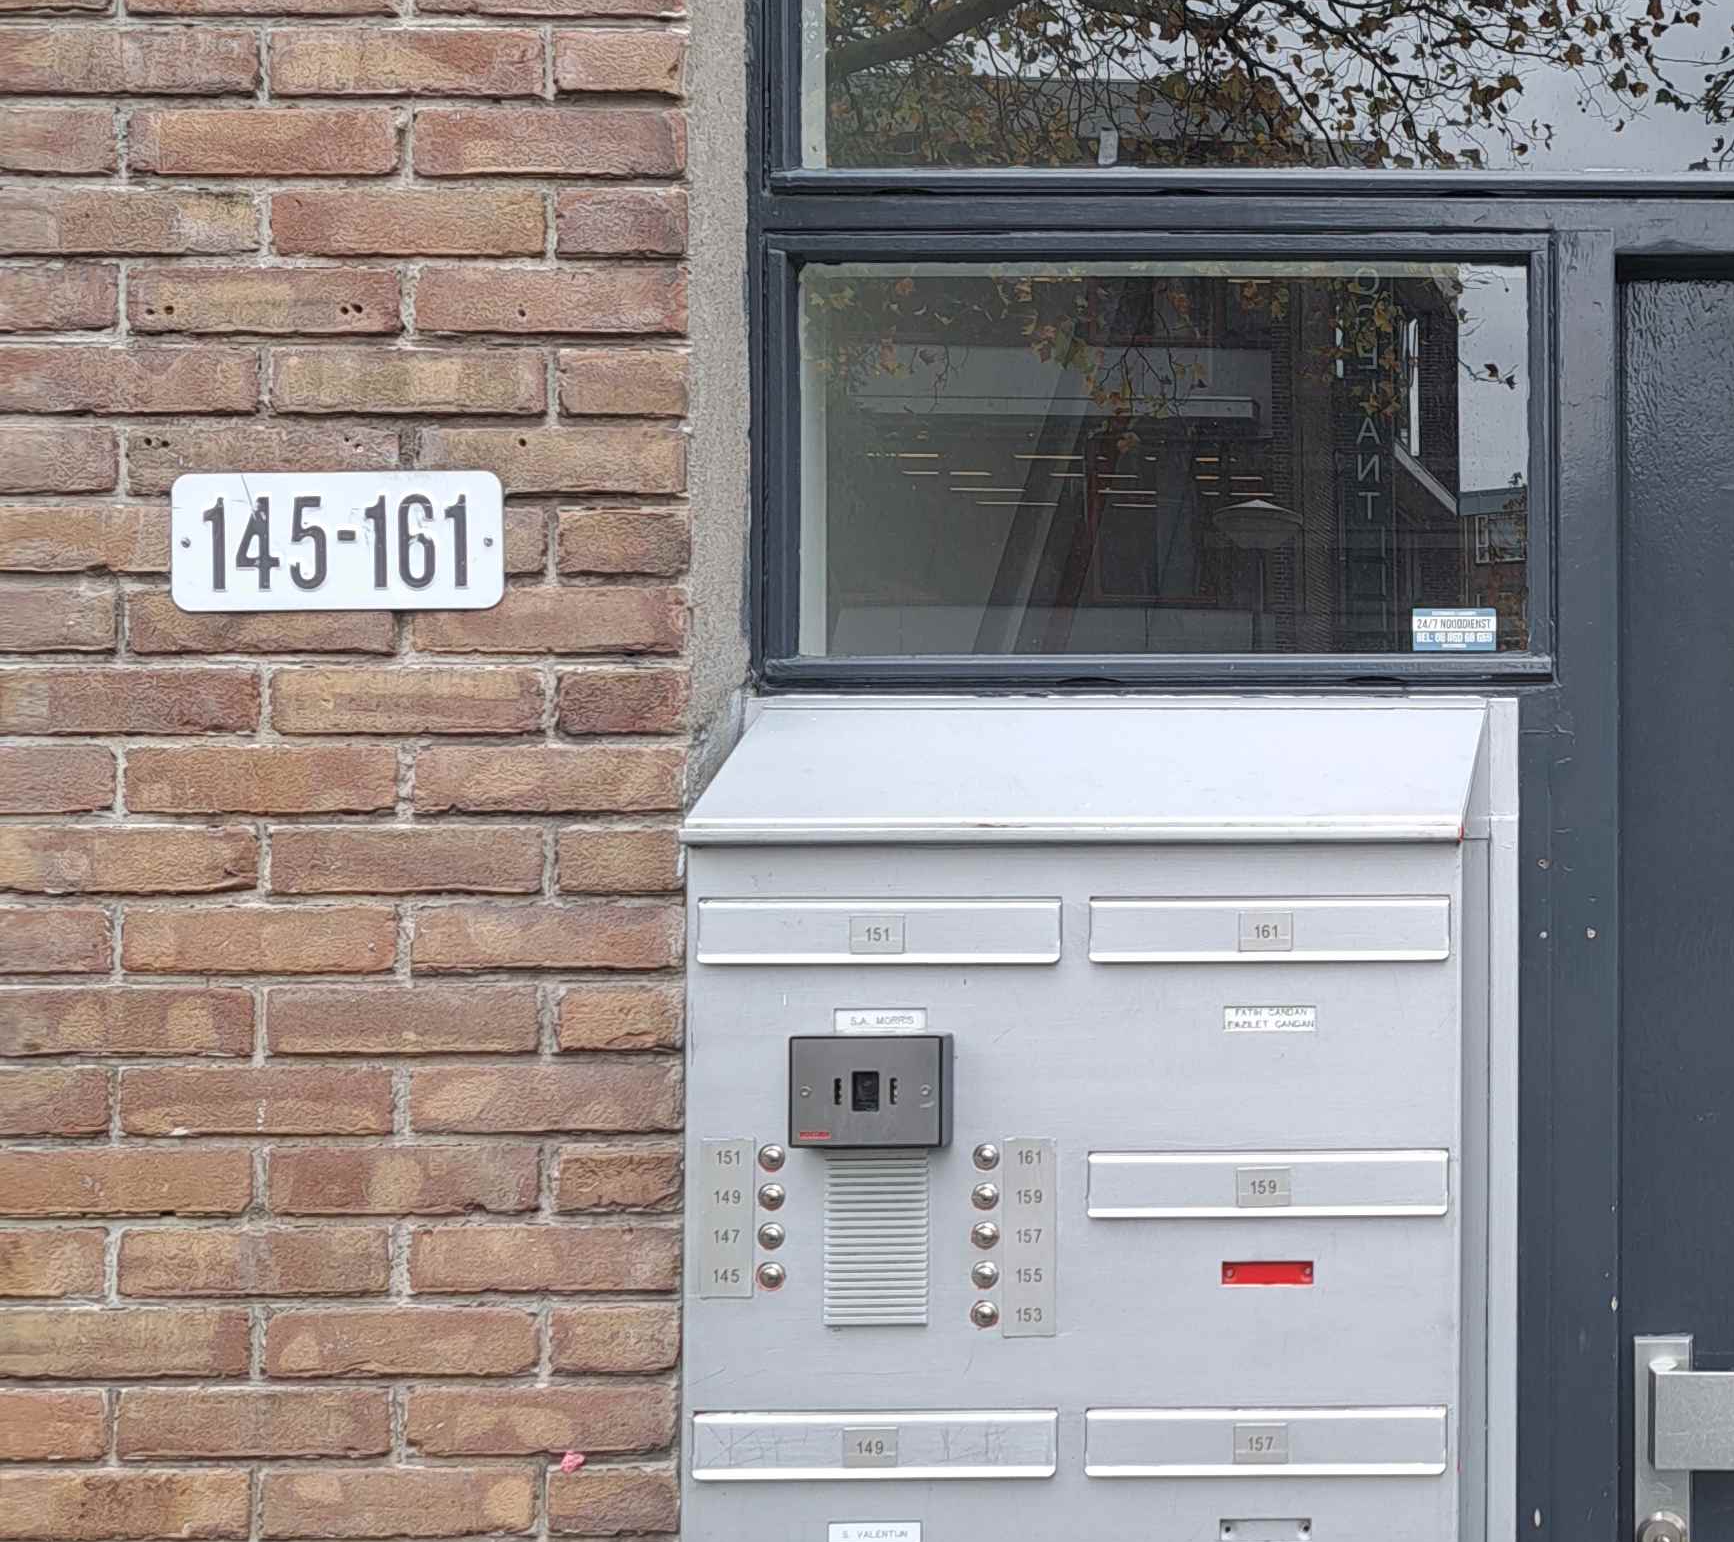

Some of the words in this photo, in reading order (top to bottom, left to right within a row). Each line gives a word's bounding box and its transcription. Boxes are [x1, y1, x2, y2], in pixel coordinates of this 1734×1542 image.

[203, 493, 469, 592] 145-161
[1417, 618, 1438, 629] 24/7
[865, 927, 891, 942] 151
[1254, 925, 1279, 939] 161
[716, 1150, 741, 1165] 151
[1017, 1150, 1042, 1165] 161
[1250, 1179, 1277, 1194] 159
[713, 1190, 741, 1204] 149
[1016, 1189, 1043, 1204] 159
[713, 1229, 740, 1244] 147
[1016, 1228, 1043, 1244] 157
[713, 1269, 740, 1284] 145
[1016, 1268, 1043, 1284] 155
[1016, 1308, 1043, 1323] 153
[856, 1439, 884, 1455] 149
[1247, 1436, 1274, 1451] 157
